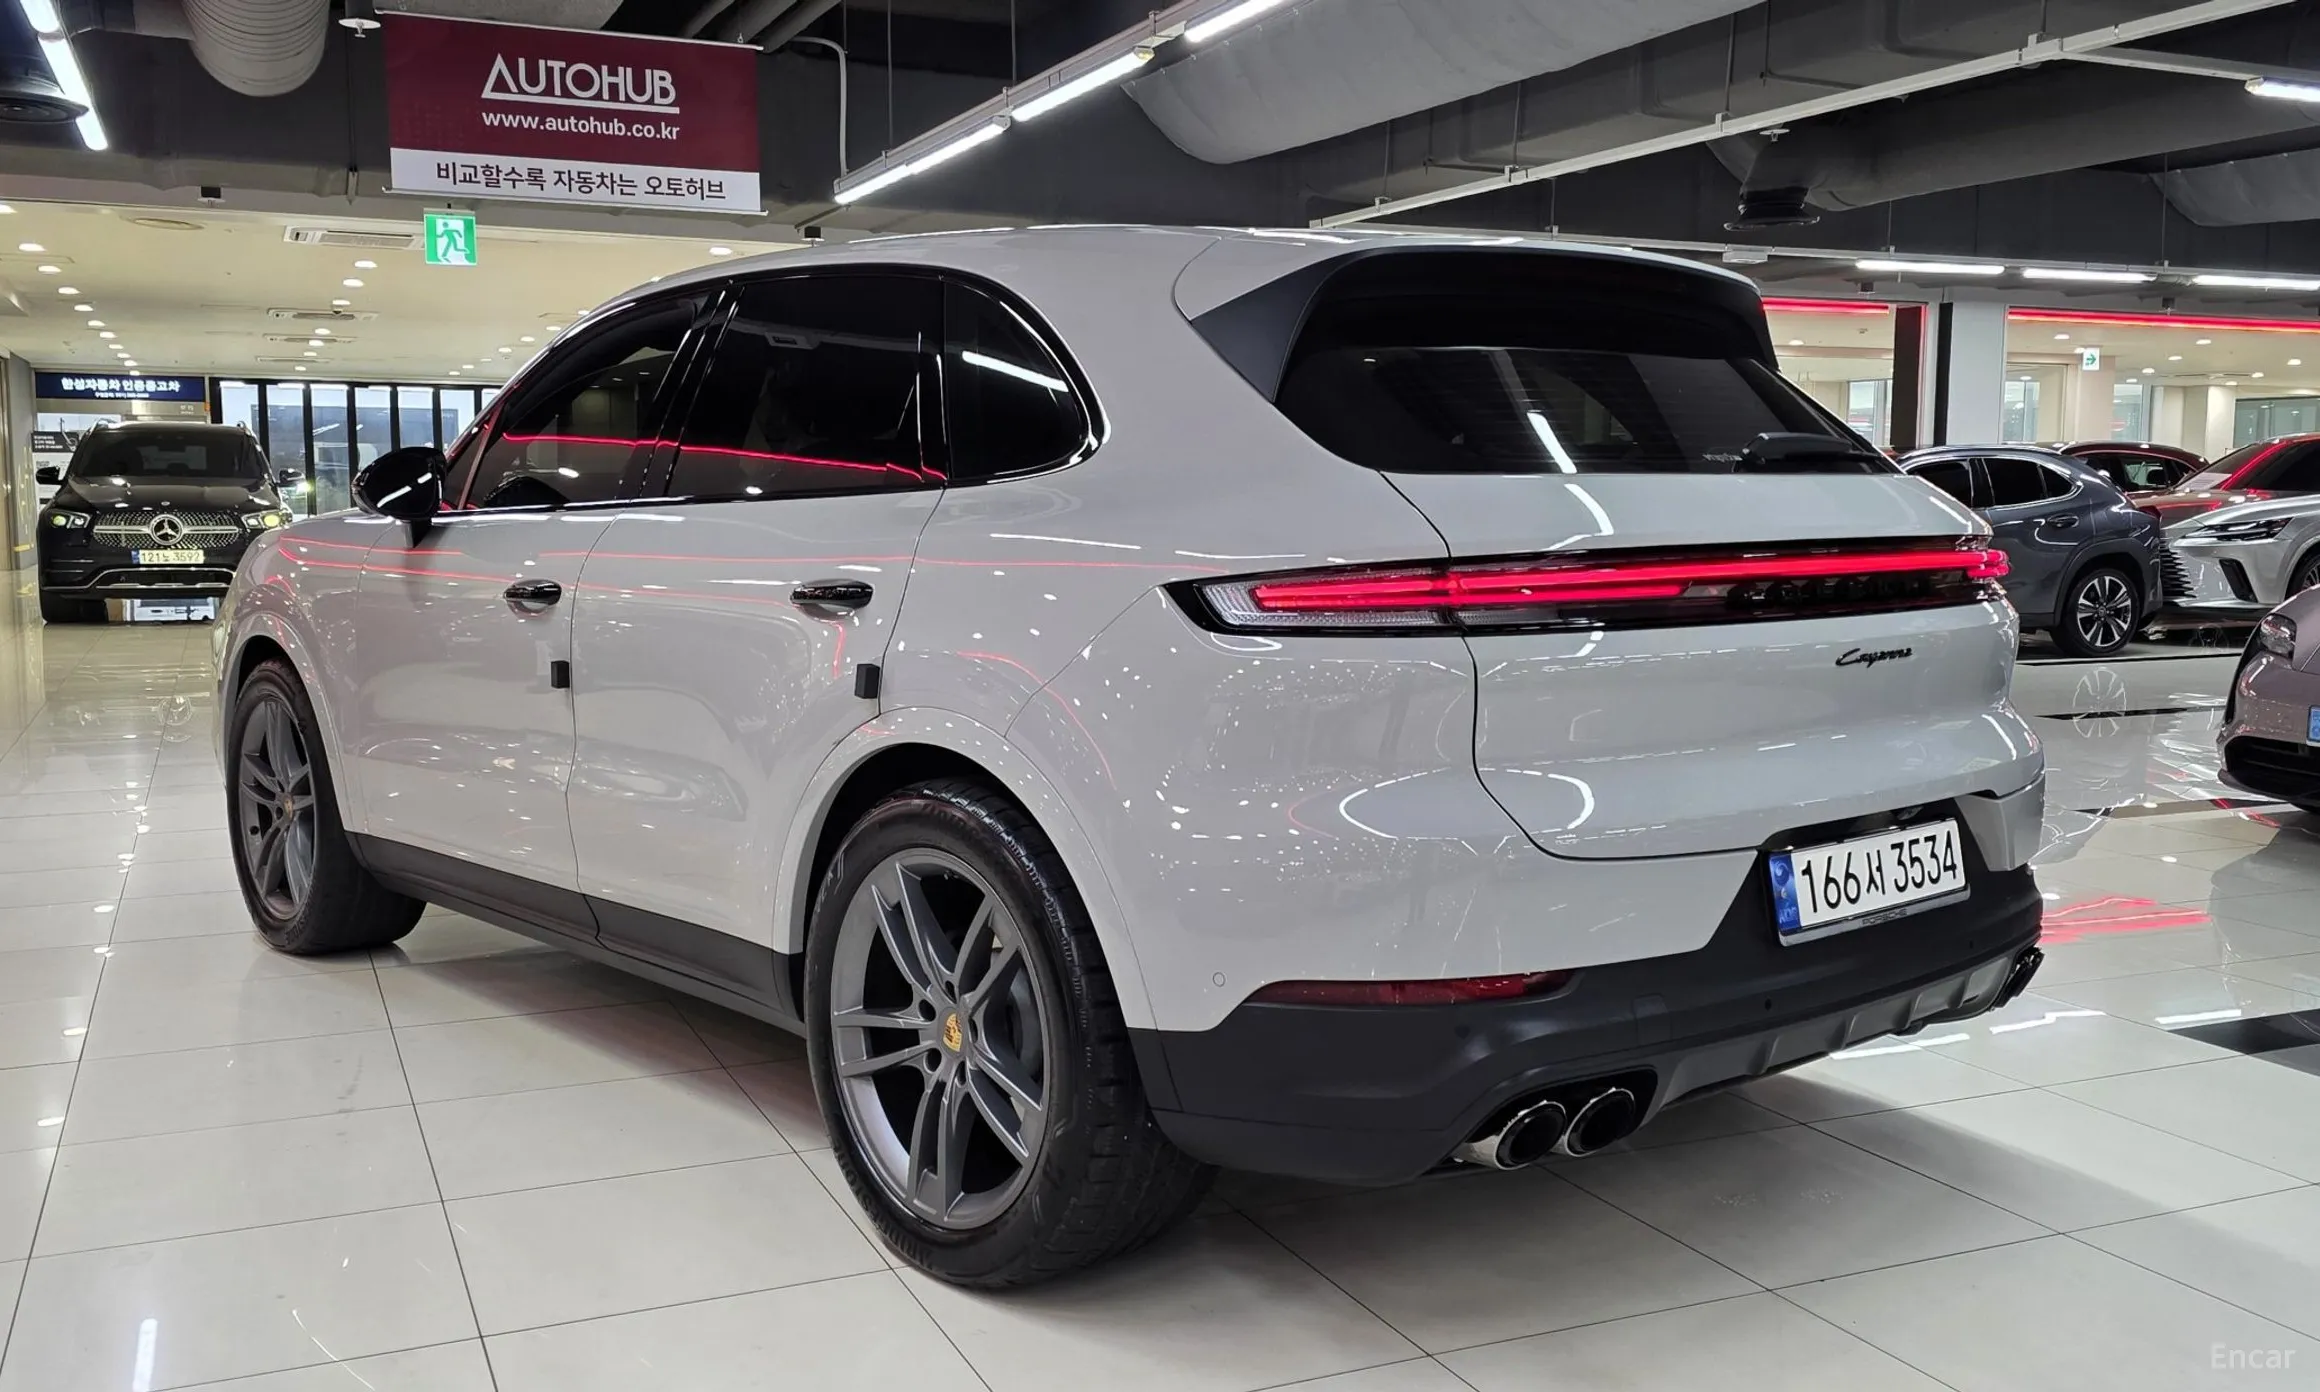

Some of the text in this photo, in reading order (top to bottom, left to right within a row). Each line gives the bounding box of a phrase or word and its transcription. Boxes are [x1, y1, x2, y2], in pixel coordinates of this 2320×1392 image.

[481, 53, 680, 113] AUTOHUB
[482, 111, 680, 140] www.autohub.co.kr
[436, 162, 726, 200] 비교할수록 자동차는 오토허브
[1835, 647, 1913, 668] Cayenne
[1801, 829, 1957, 913] 166서 3534
[1861, 908, 1908, 925] PORSCHE
